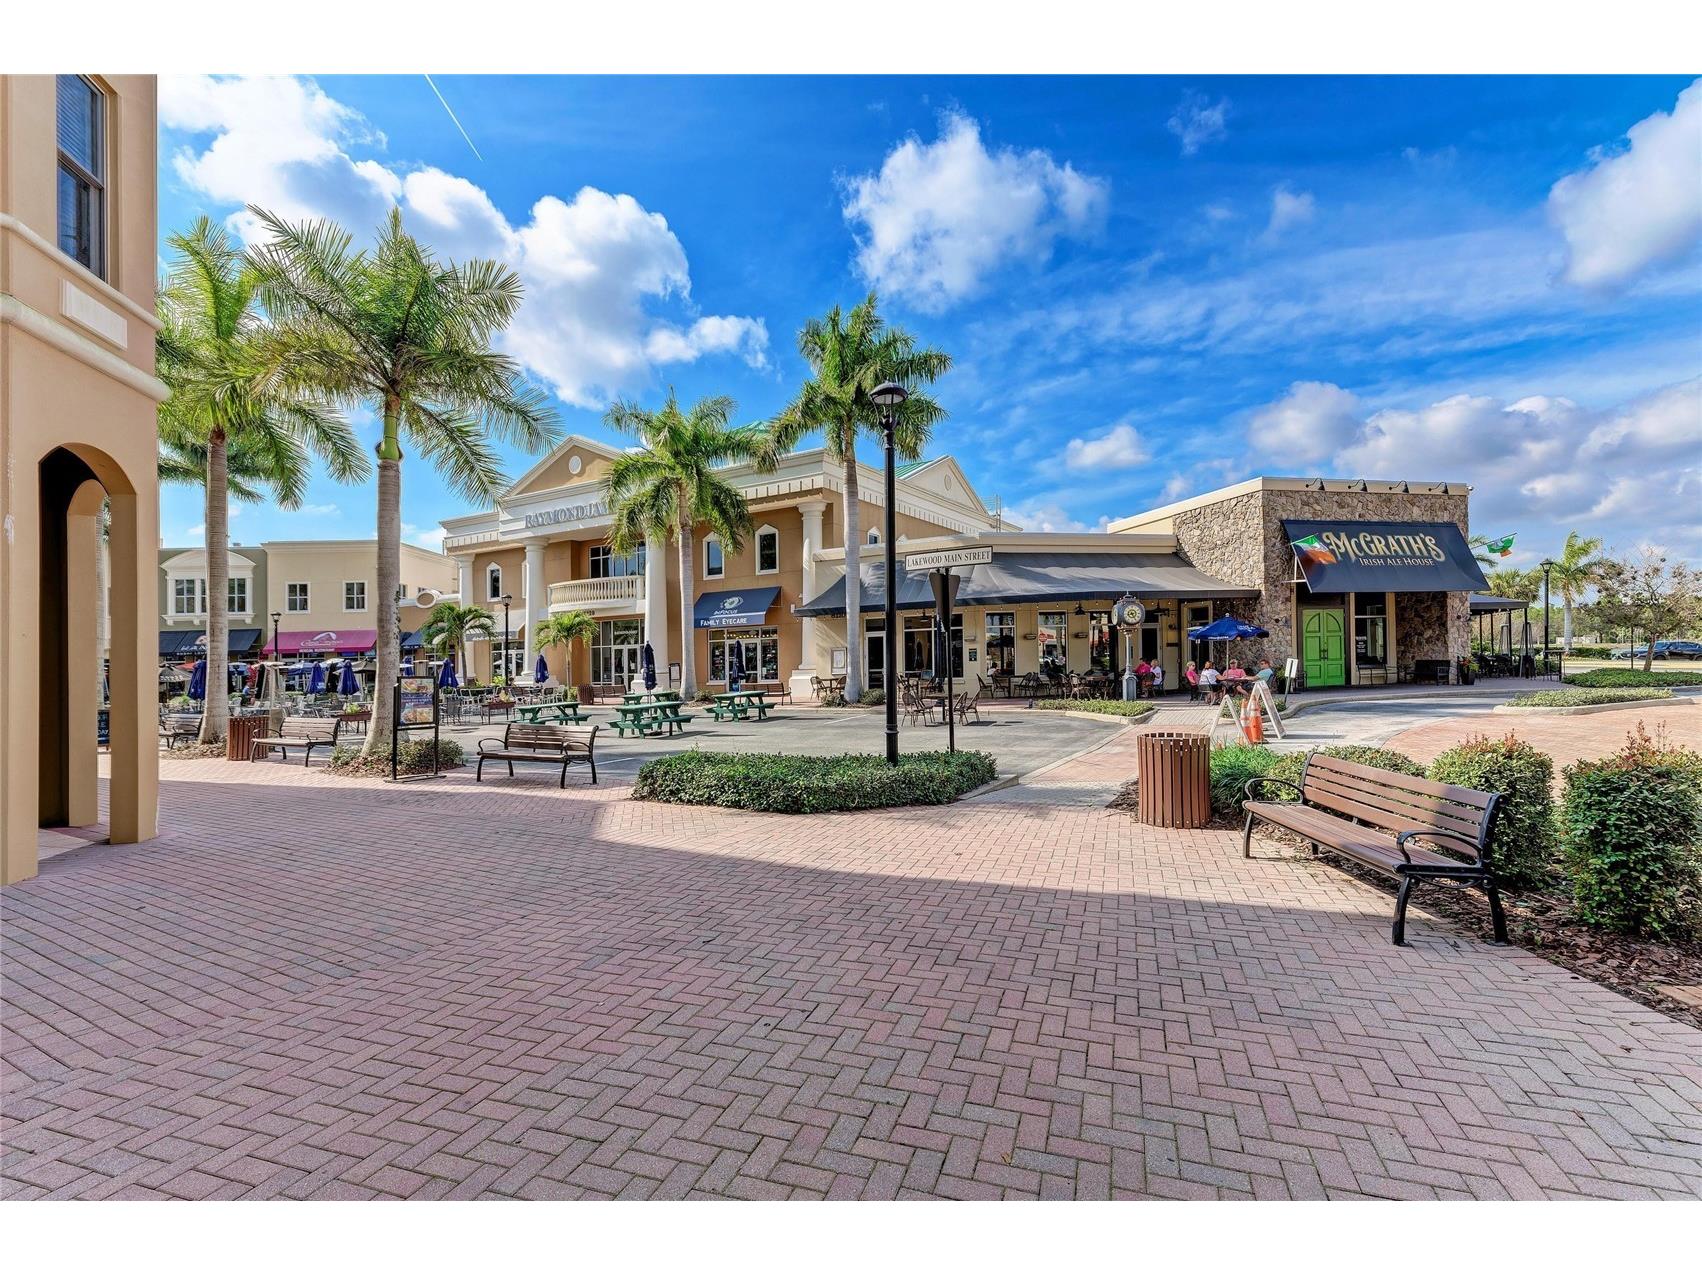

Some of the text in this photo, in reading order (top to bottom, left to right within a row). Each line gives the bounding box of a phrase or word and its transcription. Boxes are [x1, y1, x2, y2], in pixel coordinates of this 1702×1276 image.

[525, 504, 585, 528] RAYMOND
[908, 551, 990, 567] LAKEWOOD MAIN STREET
[1359, 557, 1435, 566] IRISH ALE HOUSE
[700, 617, 748, 627] FAMILY EYECARE
